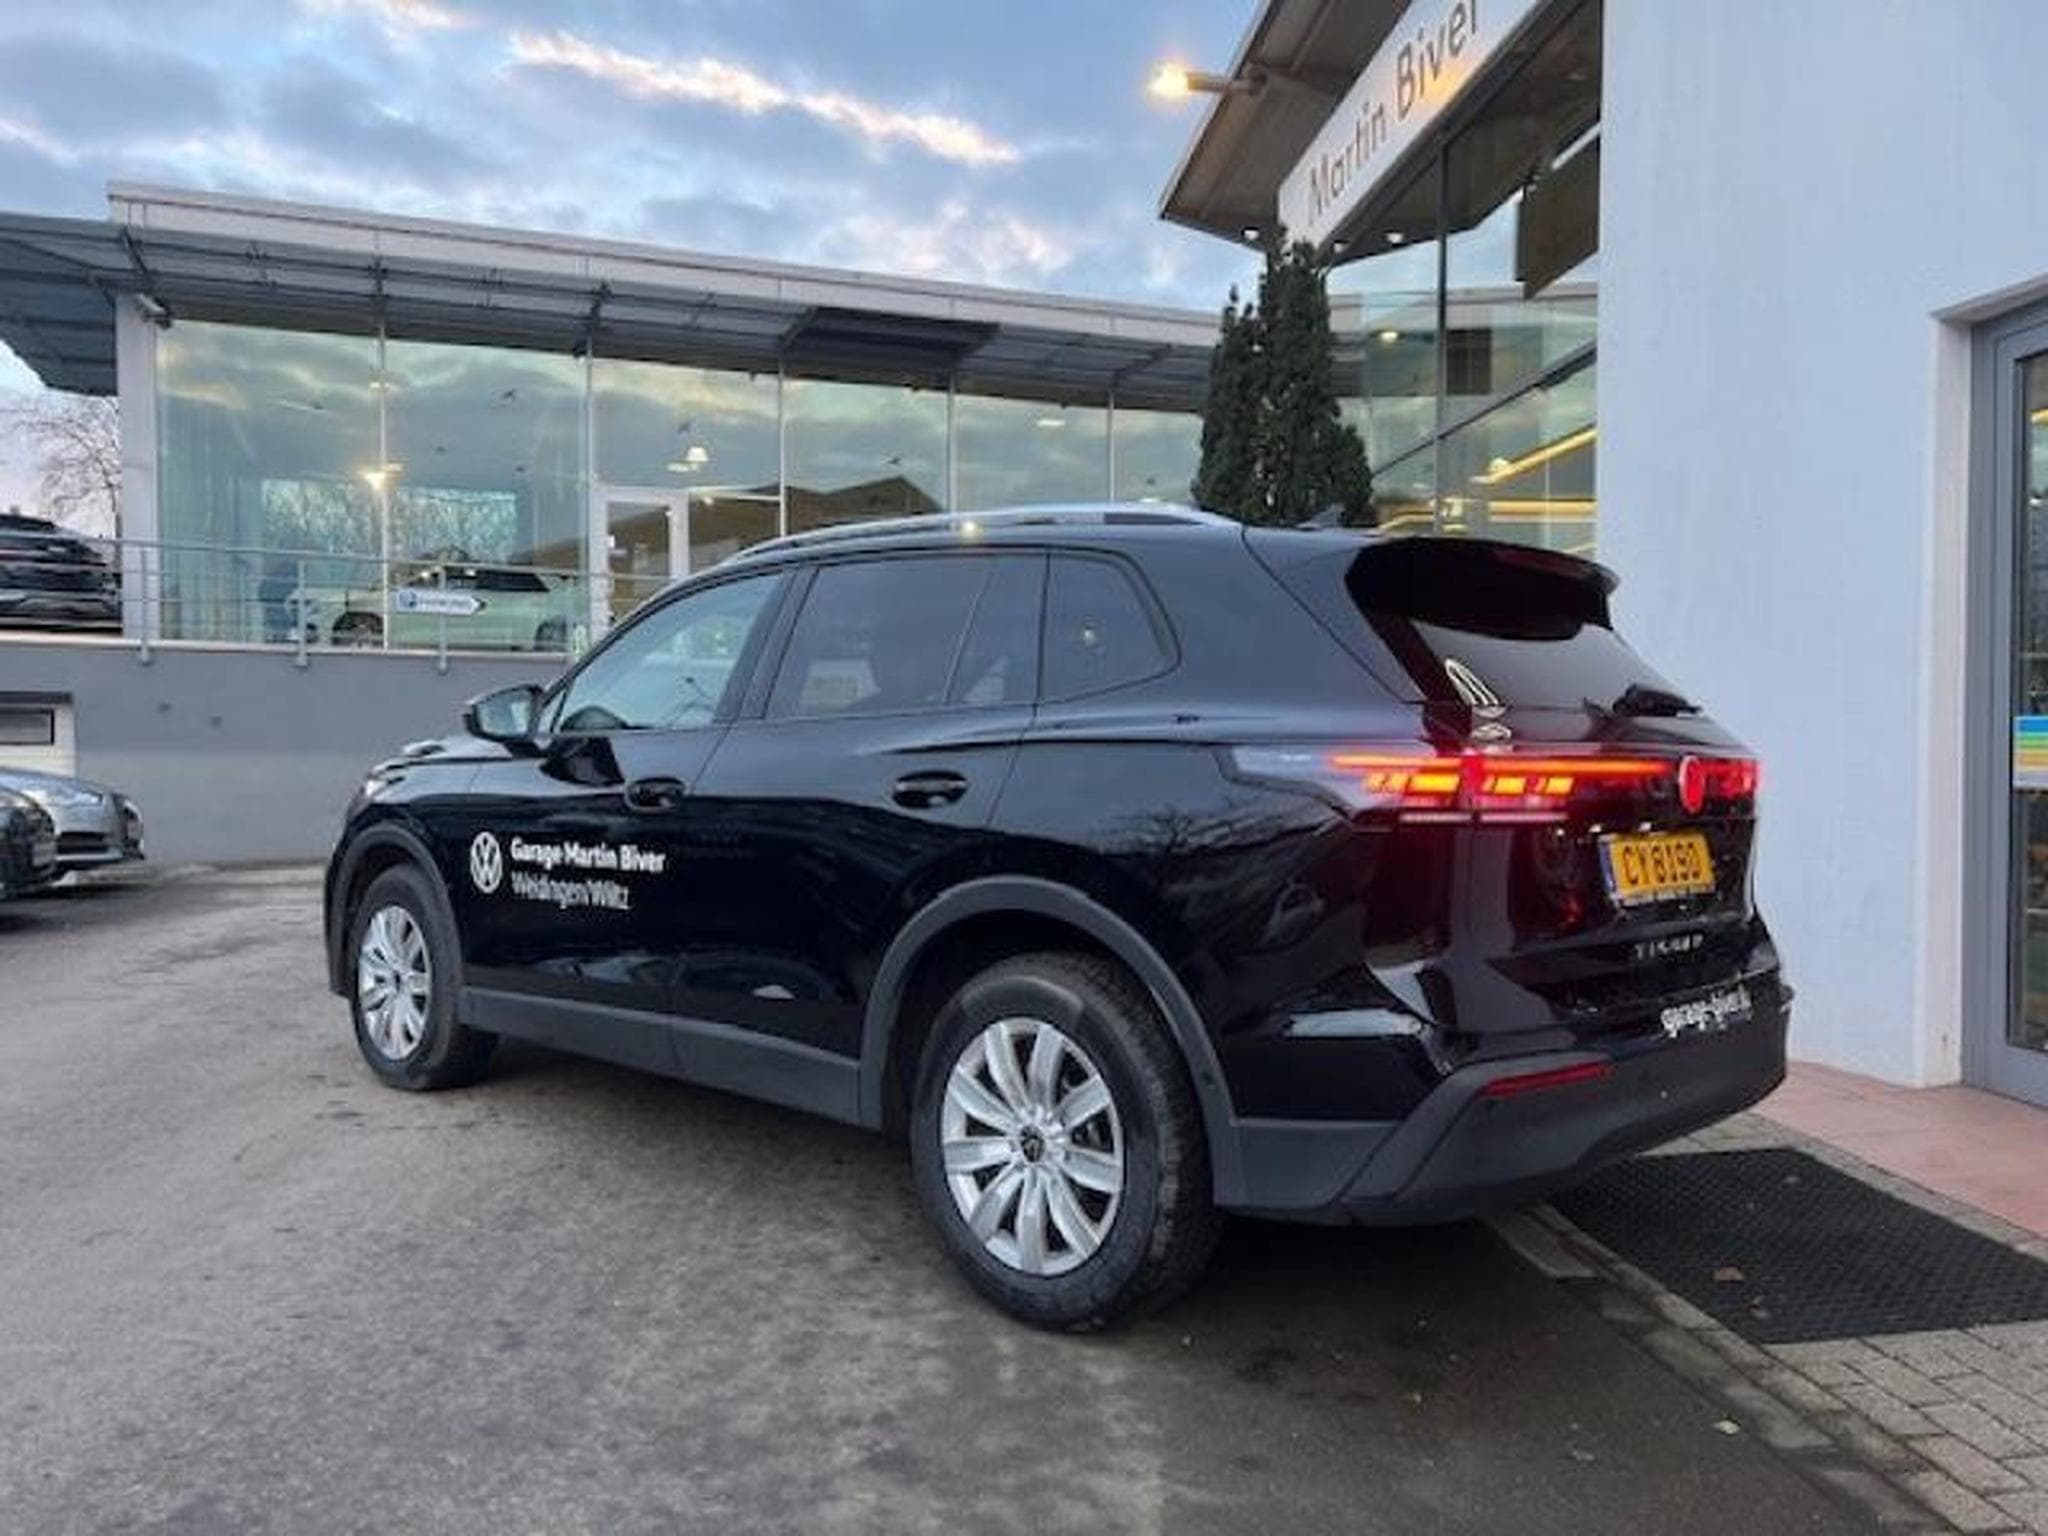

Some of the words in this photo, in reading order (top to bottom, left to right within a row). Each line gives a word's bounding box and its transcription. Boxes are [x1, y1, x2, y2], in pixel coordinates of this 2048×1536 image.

[1309, 102, 1387, 217] Martin
[510, 836, 562, 870] Garage
[563, 841, 618, 869] Martin
[620, 845, 666, 872] Biver
